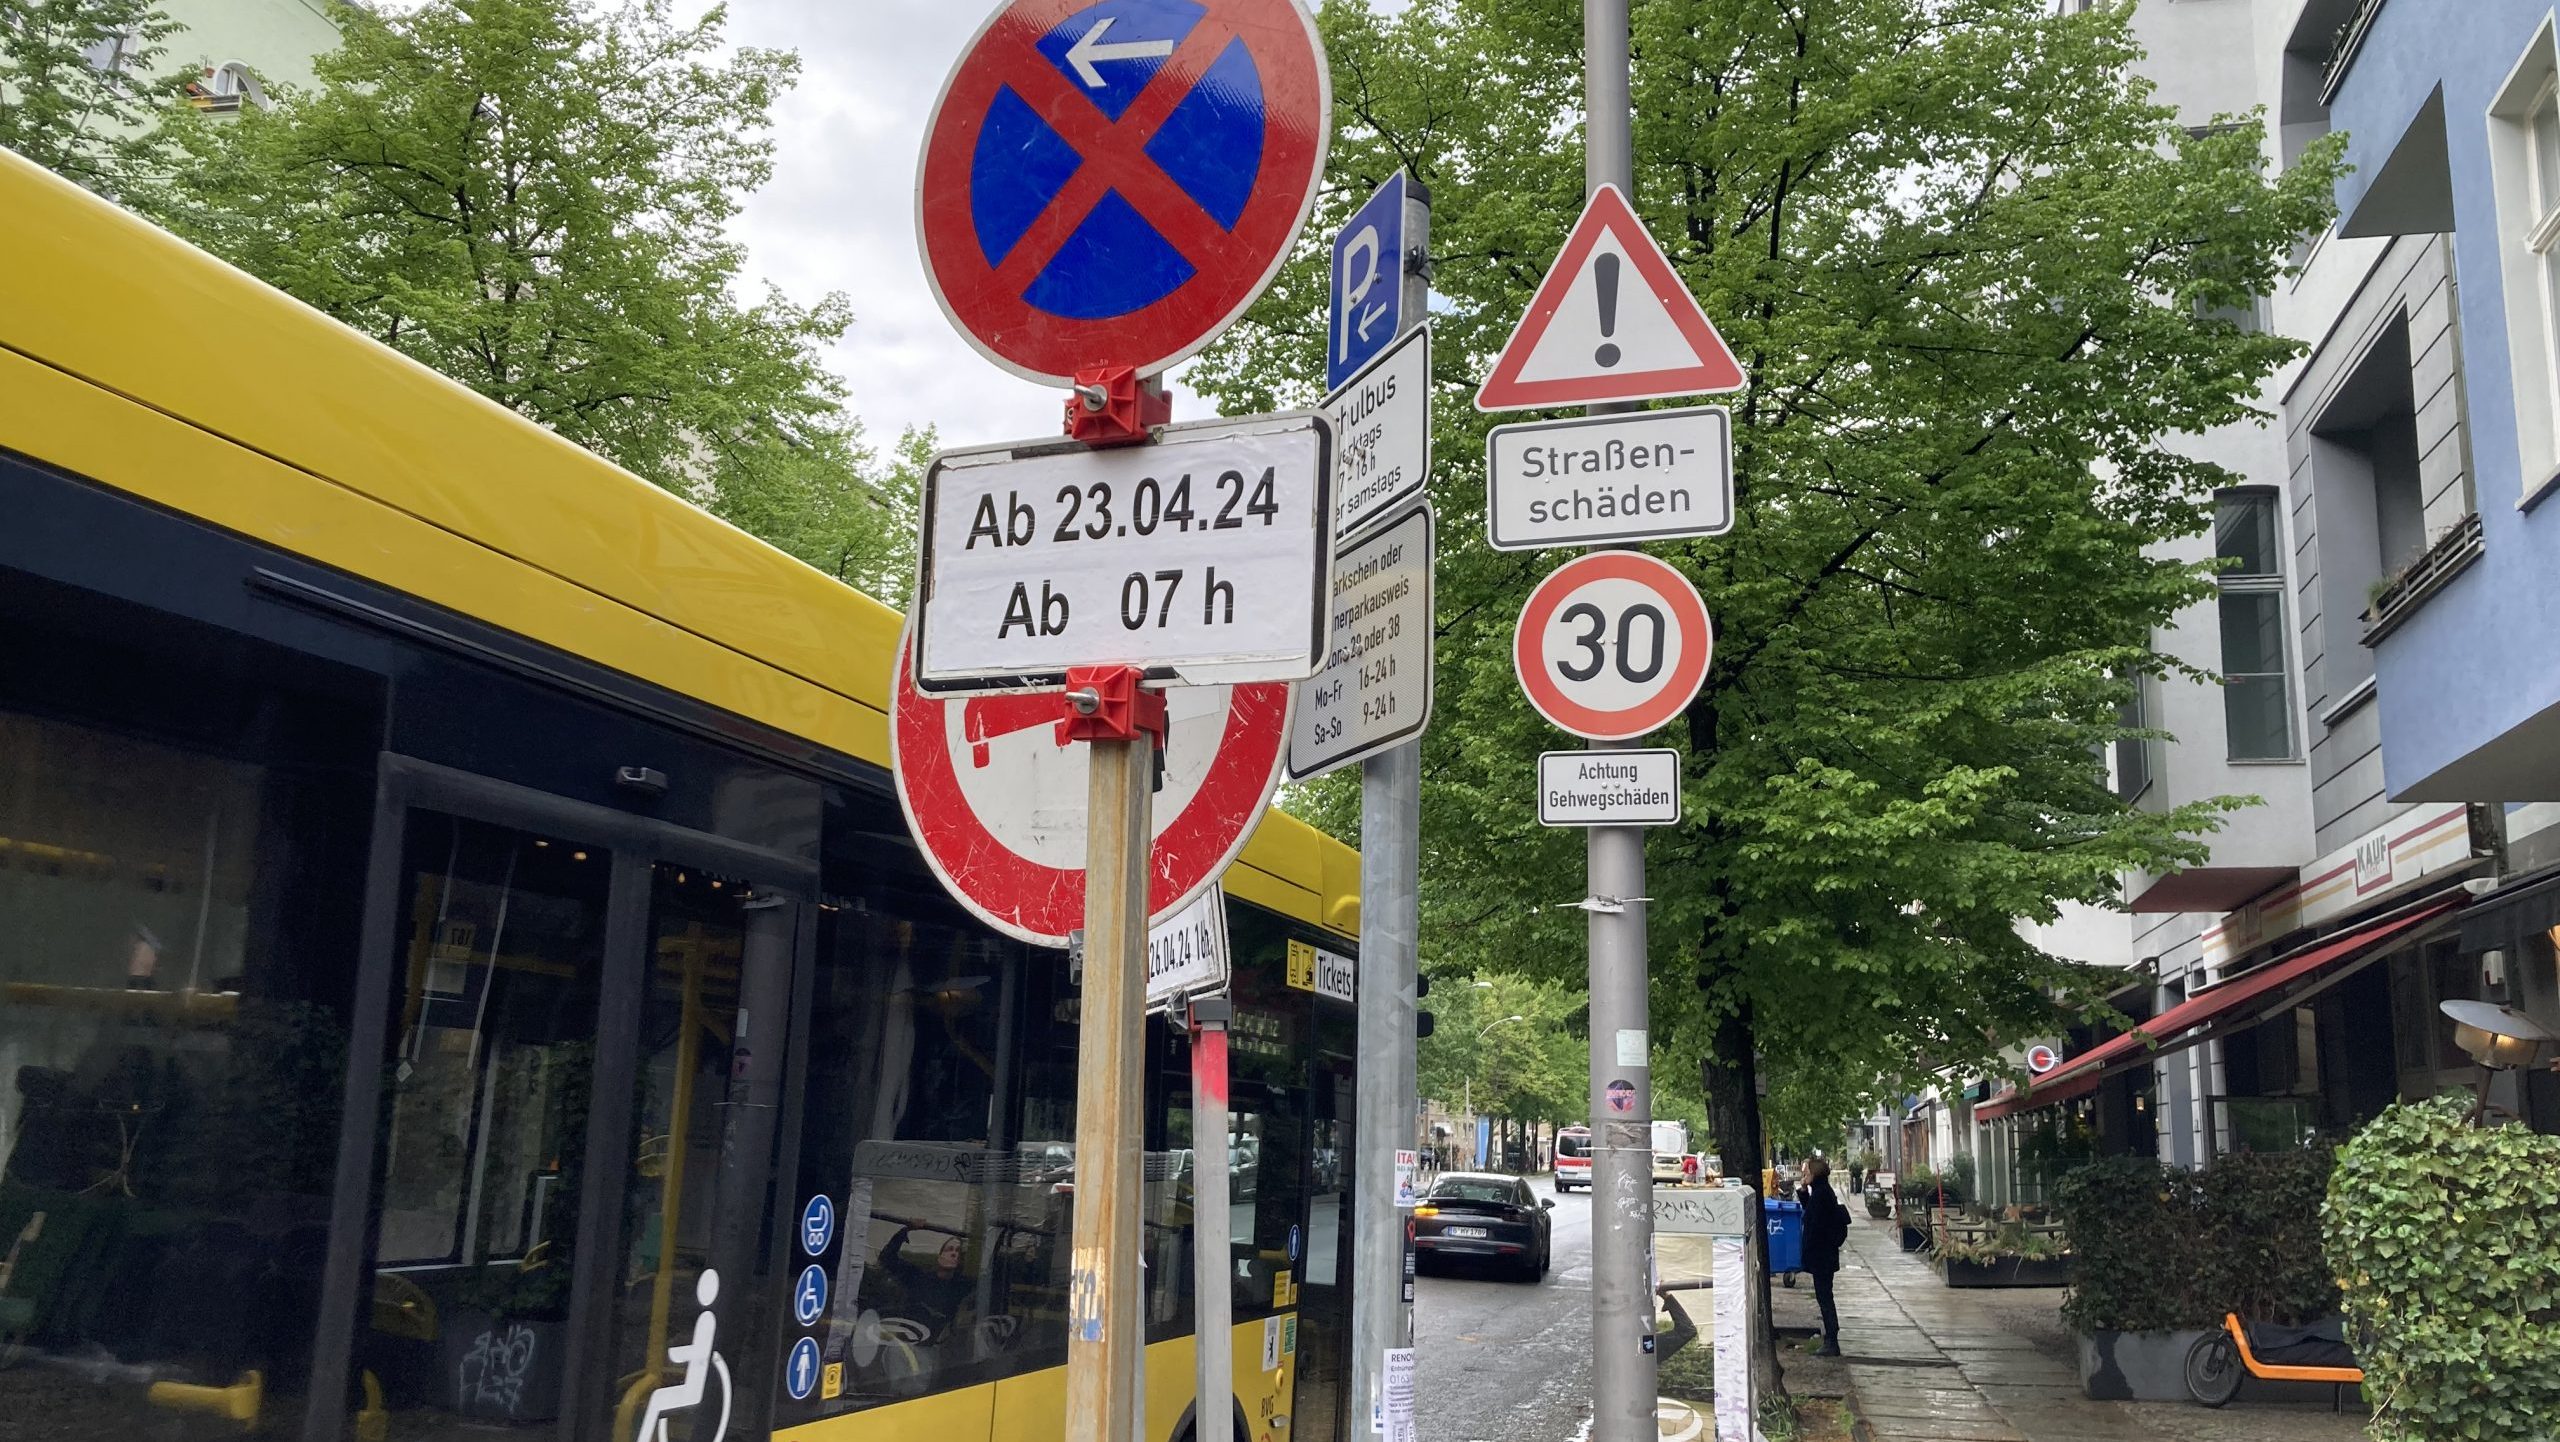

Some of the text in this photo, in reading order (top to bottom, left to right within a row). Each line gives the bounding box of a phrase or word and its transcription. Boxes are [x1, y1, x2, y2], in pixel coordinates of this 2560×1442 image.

[1338, 224, 1379, 366] P
[1336, 374, 1396, 435] hulbus
[1370, 450, 1376, 471] h
[1521, 439, 1696, 478] Straßen-
[965, 466, 1279, 550] Ab 23.04.24
[1347, 465, 1401, 514] samstags
[1529, 483, 1691, 524] schäden
[1333, 543, 1403, 597] arkschein oder
[997, 566, 1235, 640] Ab 07 h
[1334, 575, 1409, 632] nerparkausweis
[1365, 625, 1386, 652] oder
[1388, 613, 1400, 640] 38
[1557, 602, 1666, 684] 30
[1315, 653, 1396, 711] Mo-Fr 16-24 h
[1314, 690, 1396, 746] Sa-So 9-24 h
[1578, 762, 1638, 783] Achtung
[1549, 788, 1669, 812] Gehwegschäden
[1318, 955, 1351, 997] Tickets
[1261, 1395, 1274, 1418] BVG
